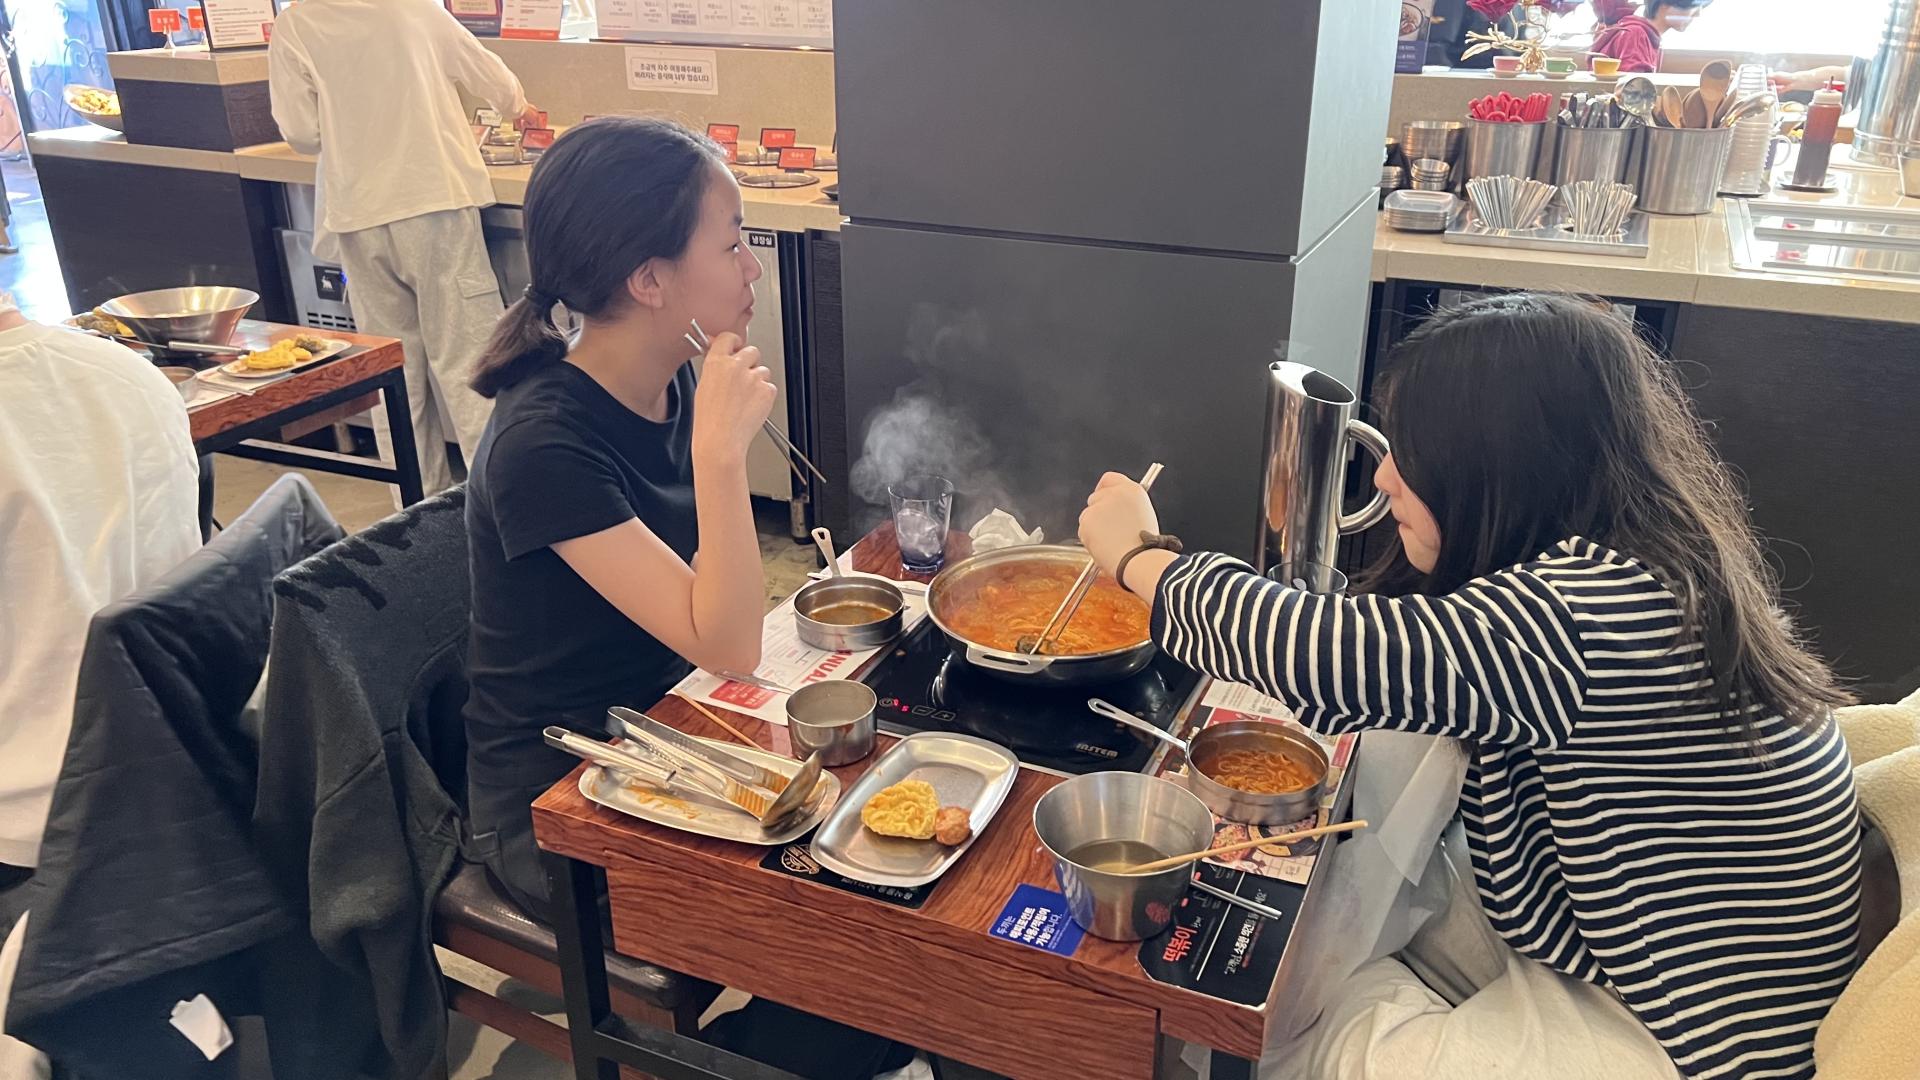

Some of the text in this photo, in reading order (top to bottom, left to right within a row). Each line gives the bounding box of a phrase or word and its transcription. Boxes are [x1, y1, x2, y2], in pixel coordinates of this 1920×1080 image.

[751, 235, 772, 246] 냉장실
[996, 915, 1016, 935] 두끼는
[1009, 907, 1036, 938] 해피포인트
[1022, 907, 1051, 943] 사용/적립이
[1036, 914, 1063, 947] 가능합니다.
[1163, 925, 1198, 962] 떡볶이
